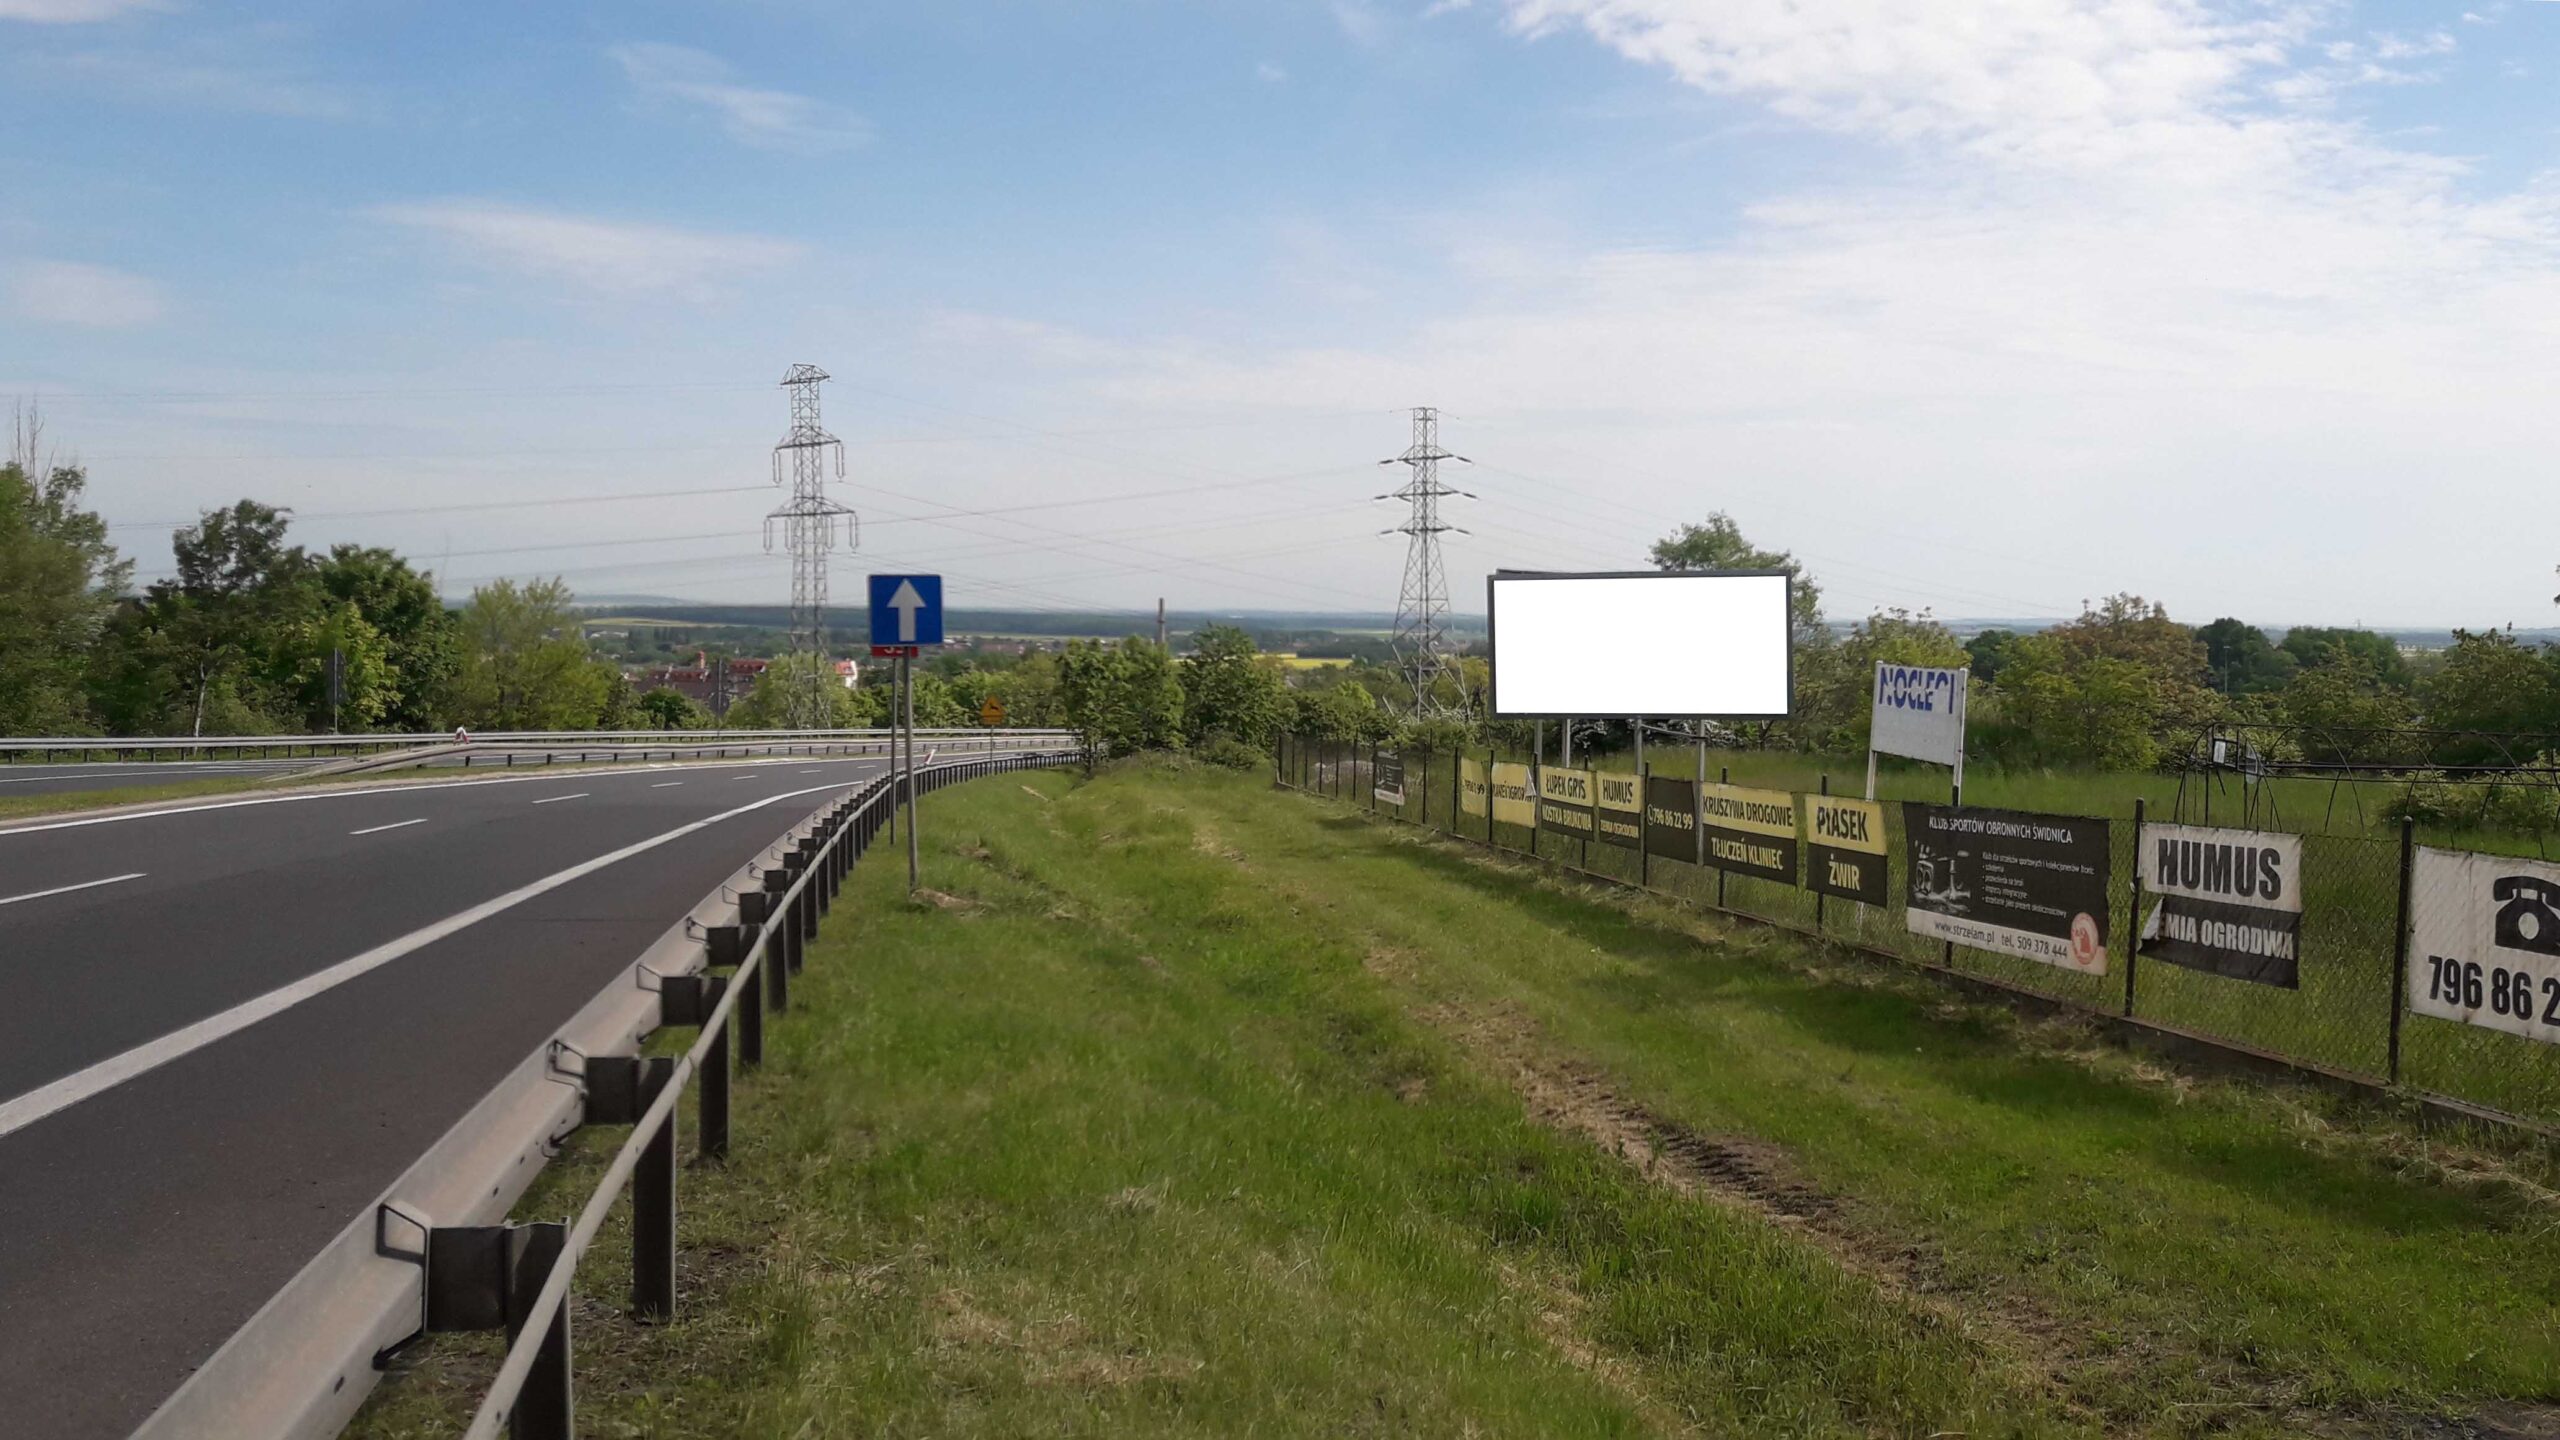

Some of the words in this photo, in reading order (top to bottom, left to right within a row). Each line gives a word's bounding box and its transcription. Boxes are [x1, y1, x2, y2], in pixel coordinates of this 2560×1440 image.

[1546, 773, 1566, 797] ŁUPEK
[1567, 777, 1586, 800] GRYS
[1603, 778, 1633, 804] HUMUS
[1653, 807, 1664, 825] 796
[1673, 811, 1682, 829] 22
[1682, 812, 1693, 830] 99
[1703, 796, 1745, 821] KRUSZYWA
[1746, 802, 1793, 827] DROGOWE
[1816, 806, 1869, 842] PIASEK
[1928, 815, 1949, 831] KLUB
[1949, 816, 1985, 833] SPORTÓW
[1986, 821, 2031, 839] OBRONNYCH
[2032, 823, 2073, 844] ŚWIDNICA
[1711, 836, 1747, 863] TŁUCZEŃ
[1748, 845, 1784, 870] KLINIEC
[2158, 838, 2281, 901] HUMUS
[1828, 853, 1860, 891] ŻWIR
[1934, 920, 1995, 945] www.strzelam.pl
[2017, 935, 2032, 951] 509
[2034, 939, 2050, 955] 378
[2051, 943, 2068, 958] 444
[2428, 954, 2483, 1010] 796
[2491, 967, 2533, 1021] 86
